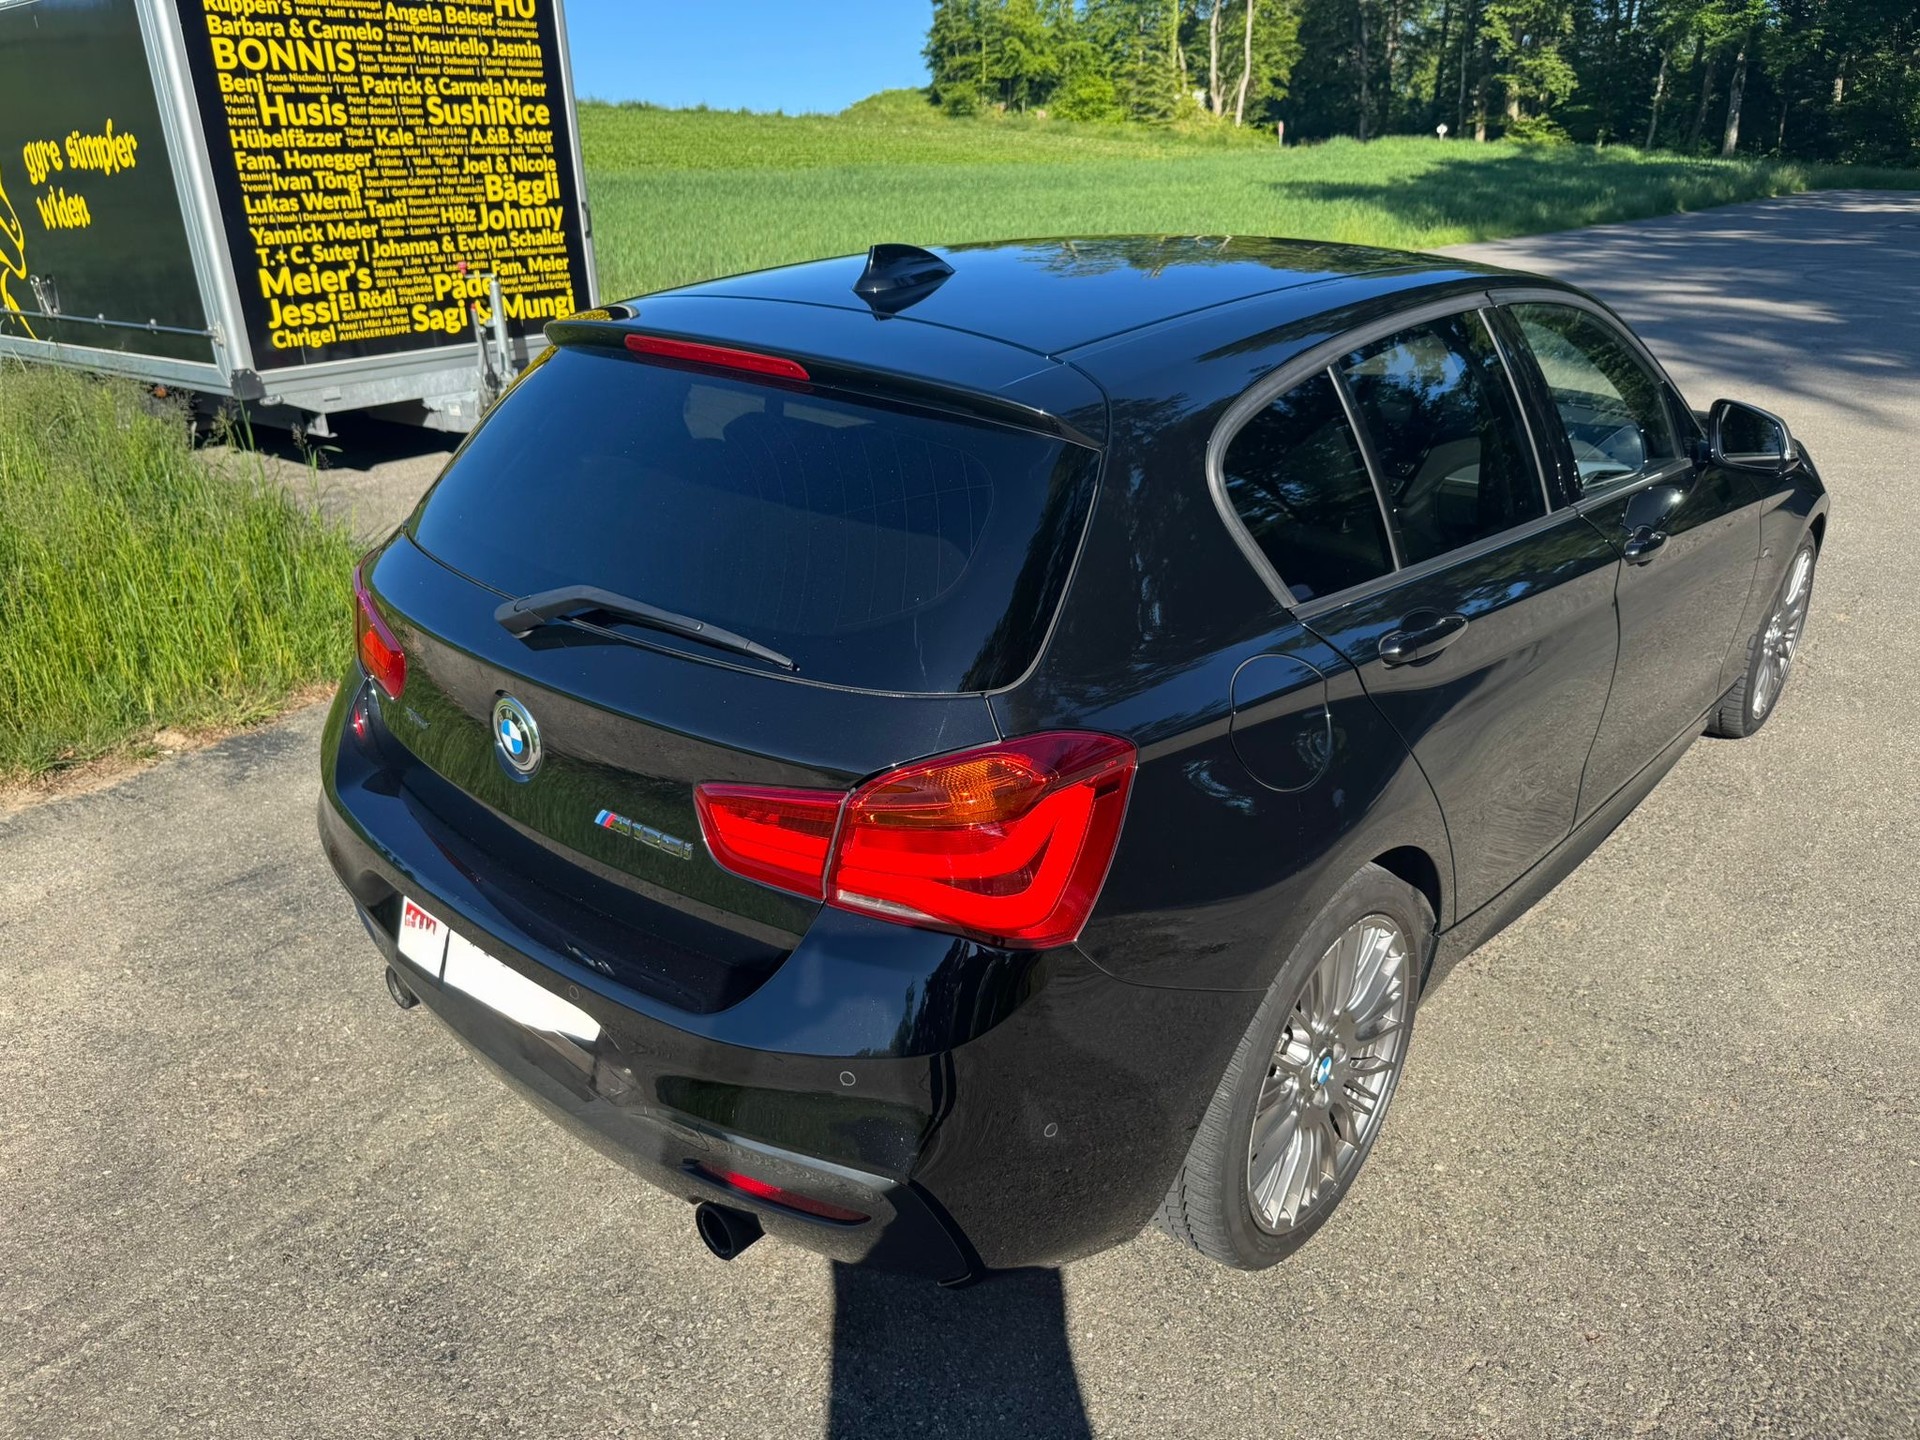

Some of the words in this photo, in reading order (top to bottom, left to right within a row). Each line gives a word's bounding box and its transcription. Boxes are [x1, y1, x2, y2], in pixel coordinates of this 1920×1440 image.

[348, 9, 356, 18] &
[358, 10, 383, 20] Marcel
[384, 2, 442, 25] Angela
[444, 6, 494, 26] Belser
[206, 14, 286, 37] Barbara
[289, 18, 306, 38] &
[308, 19, 384, 41] Carmelo
[386, 33, 410, 42] Bruno
[210, 37, 356, 72] BONNIS
[385, 43, 392, 52] &
[412, 35, 489, 56] Mauriello
[492, 38, 542, 58] Jasmin
[266, 72, 288, 82] Jonas
[362, 75, 424, 95] Patrick
[424, 76, 438, 95] &
[438, 76, 502, 97] Carmela
[502, 78, 546, 98] Meier
[225, 105, 257, 116] Yasmin
[228, 116, 259, 126] Mariel
[258, 94, 348, 126] Husis
[426, 96, 550, 126] SushiRice
[230, 128, 342, 149] Hübelfäzzer
[375, 126, 414, 146] Kale
[514, 127, 553, 144] Suter
[23, 140, 64, 185] gyre
[234, 151, 281, 171] Fam.
[283, 149, 372, 172] Honegger
[462, 155, 493, 174] Joel
[496, 155, 508, 174] &
[510, 154, 557, 174] Nicole
[242, 182, 272, 192] Yvonne
[272, 171, 313, 192] Ivan
[313, 169, 363, 191] Töngi
[484, 172, 560, 206] Bäggli
[243, 193, 300, 214] Lukas
[300, 190, 362, 211] Wernli
[364, 198, 408, 218] Tanti
[440, 204, 477, 224] Hölz
[478, 201, 564, 232] Johnny
[249, 222, 325, 246] Yannick
[326, 220, 378, 241] Meier
[372, 238, 440, 258] Johanna
[442, 234, 456, 253] &
[458, 232, 508, 255] Evelyn
[509, 228, 566, 248] Schaller
[256, 248, 276, 266] T.
[290, 244, 310, 264] C.
[312, 244, 360, 263] Suter
[492, 259, 526, 276] Fam.
[528, 255, 569, 273] Meier
[258, 260, 372, 298] Meier's
[268, 292, 340, 329] Jessi
[338, 291, 356, 312] El
[358, 288, 398, 309] Rödi
[412, 300, 468, 334] Sagi
[502, 288, 576, 321] Mungi
[272, 324, 337, 348] Chrigel
